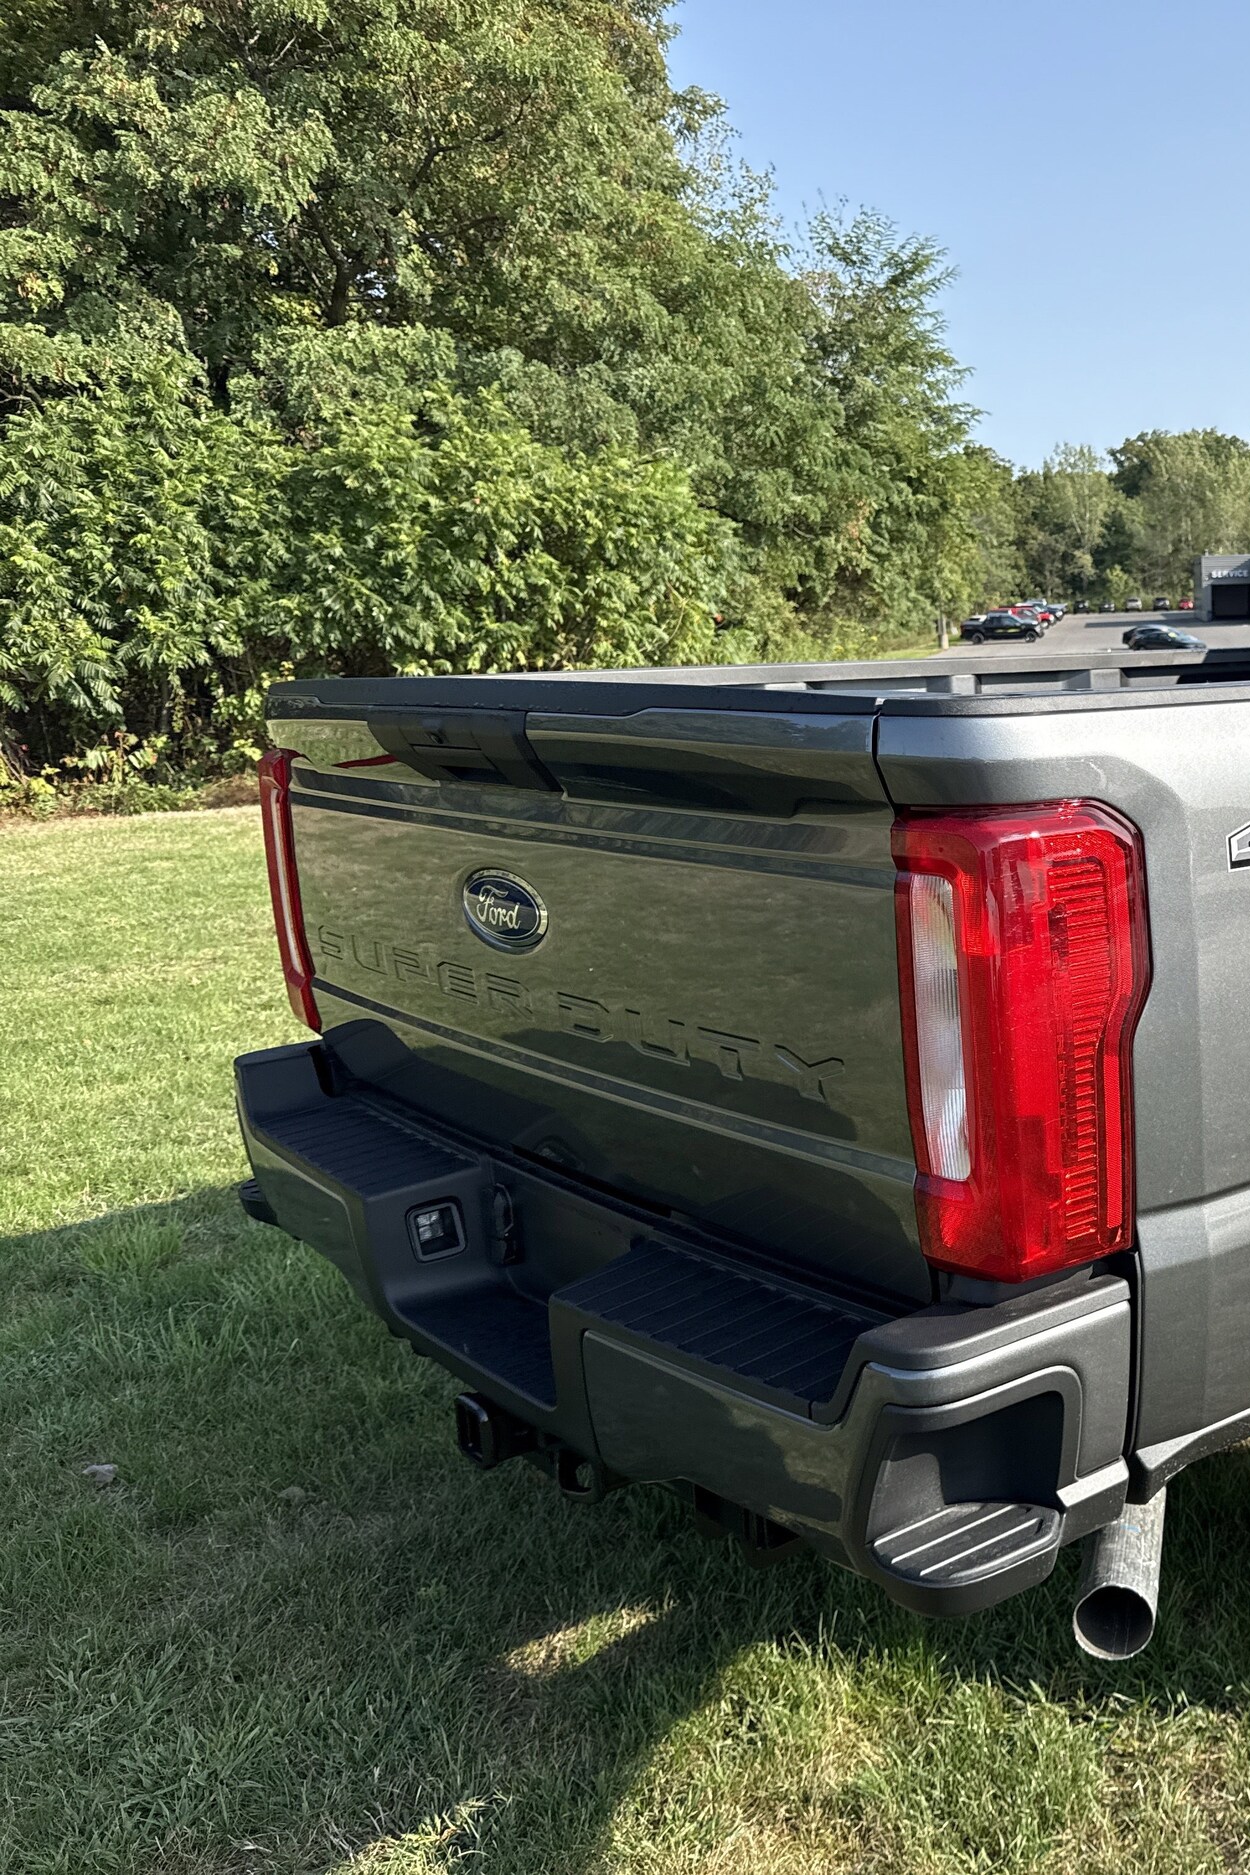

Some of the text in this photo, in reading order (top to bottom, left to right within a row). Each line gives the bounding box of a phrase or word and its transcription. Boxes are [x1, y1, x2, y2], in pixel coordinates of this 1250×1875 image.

[1211, 569, 1249, 579] SERVICE
[476, 884, 521, 930] Ford
[317, 924, 846, 1102] SUPER DUTY
